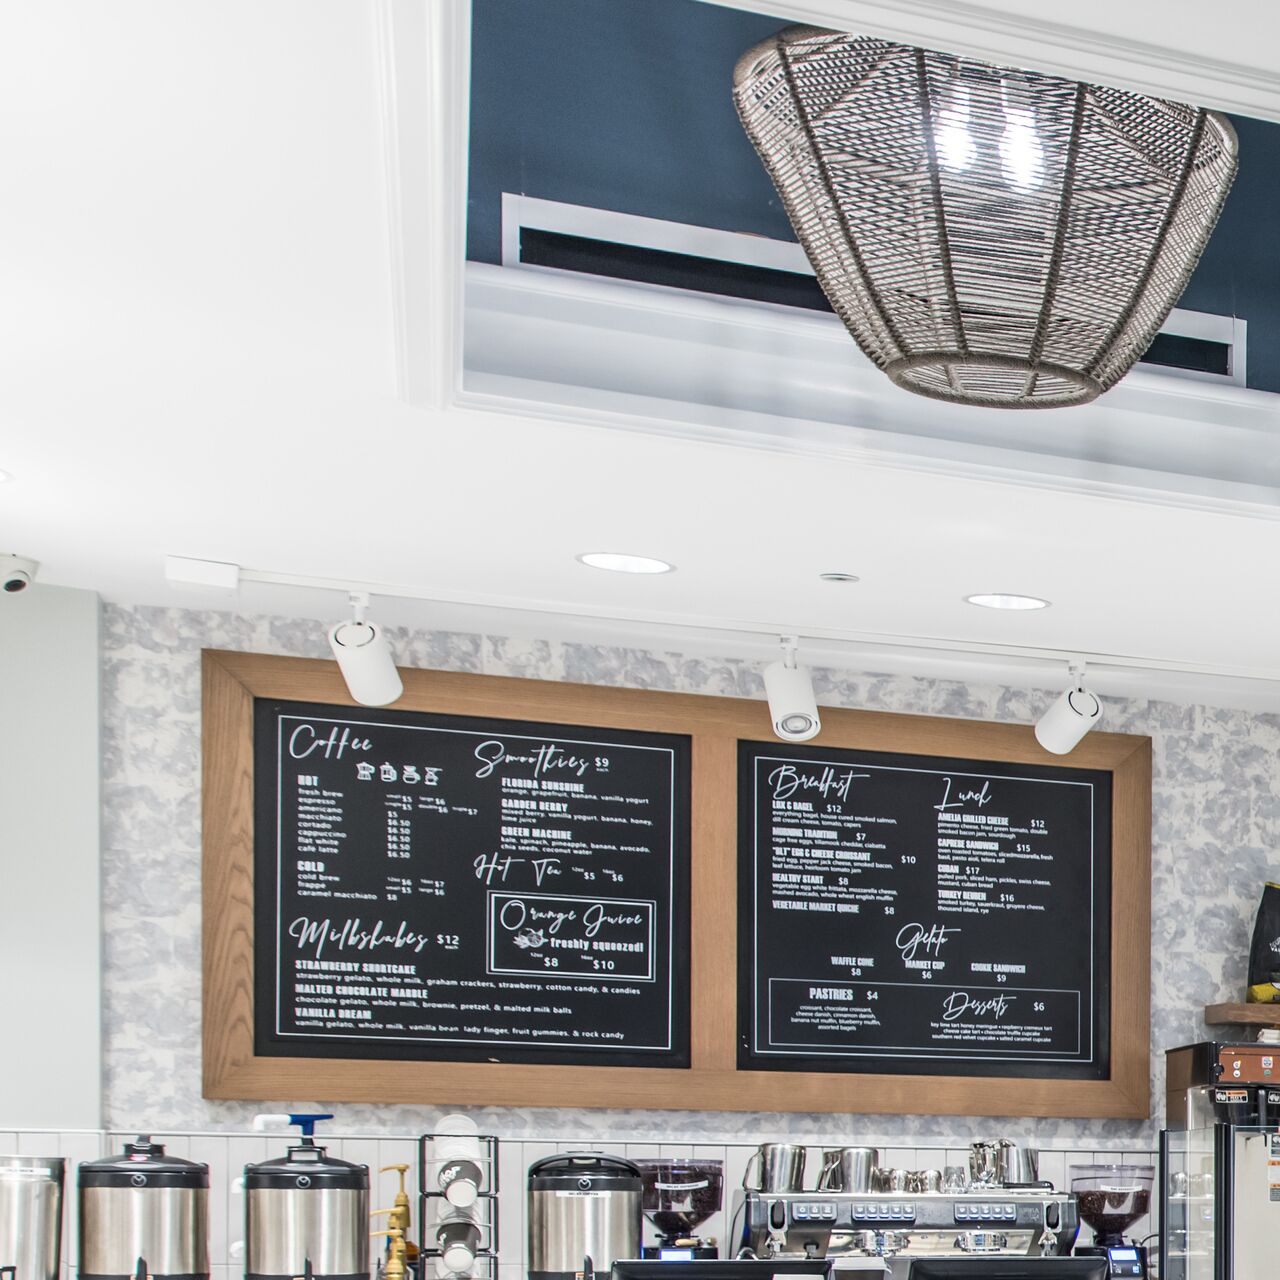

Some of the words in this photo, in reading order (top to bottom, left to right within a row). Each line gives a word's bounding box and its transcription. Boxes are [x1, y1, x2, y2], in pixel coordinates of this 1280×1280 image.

[289, 724, 373, 759] Coffee
[474, 740, 589, 778] Smoothies
[595, 757, 609, 768] $9
[297, 775, 319, 786] HOT
[502, 777, 539, 790] FLORIDA
[541, 780, 584, 793] SUNSHINE
[768, 764, 870, 802] Breakfast
[933, 777, 992, 811] Lunch
[501, 798, 536, 810] GARDEN
[539, 801, 568, 812] BERRY
[792, 801, 814, 811] BAGEL
[826, 804, 842, 813] $12
[986, 815, 1009, 826] CHEESE
[1030, 819, 1045, 828] $12
[501, 826, 530, 837] GREEN
[532, 828, 572, 840] MACHINE
[855, 832, 866, 841] $7
[938, 838, 965, 849] CAPRESE
[965, 839, 999, 851] SANDWICH
[1016, 843, 1030, 853] $15
[835, 851, 871, 861] CROISSANT
[901, 855, 916, 864] $10
[297, 861, 325, 872] COLD
[473, 852, 526, 885] Hot
[531, 858, 562, 886] Tea
[938, 864, 960, 874] CUBAN
[965, 866, 980, 875] $17
[772, 872, 801, 883] HEALTHY
[802, 874, 824, 884] START
[838, 877, 848, 886] $8
[938, 889, 962, 900] TURKEY
[1000, 893, 1014, 902] $16
[772, 899, 808, 910] VEGETABLE
[809, 901, 836, 912] MARKET
[884, 906, 894, 915] $8
[500, 899, 576, 935] Orange
[583, 903, 642, 938] Juice
[288, 917, 428, 959] Milkshakes
[437, 934, 460, 945] $12
[551, 937, 589, 951] freshly
[895, 922, 961, 961] Gelato
[295, 960, 360, 973] STRAWBERRY
[362, 963, 416, 975] SHORTCAKE
[544, 957, 559, 967] $8
[593, 960, 615, 970] $10
[831, 956, 856, 966] WAFFLE
[857, 957, 874, 967] CONE
[905, 959, 931, 969] MARKET
[931, 960, 945, 970] CUP
[971, 962, 992, 972] COOKIE
[992, 963, 1026, 974] SANDWICH
[851, 967, 861, 977] $8
[922, 971, 932, 980] $6
[996, 974, 1007, 983] $9
[295, 983, 333, 995] MALTED
[335, 985, 388, 998] CHOCOLATE
[546, 983, 572, 992] cotton
[610, 986, 641, 995] candies
[809, 987, 853, 1001] PASTRIES
[866, 990, 878, 1000] $4
[503, 1004, 531, 1012] malted
[534, 1005, 551, 1014] milk
[553, 1006, 572, 1015] balls
[942, 991, 1017, 1021] Desserts
[1034, 1001, 1045, 1011] $6
[295, 1007, 336, 1018] VANILLA
[338, 1009, 372, 1020] DREAM
[463, 1025, 481, 1034] lady
[512, 1027, 530, 1035] fruit
[582, 1030, 599, 1038] rock
[601, 1031, 624, 1040] candy
